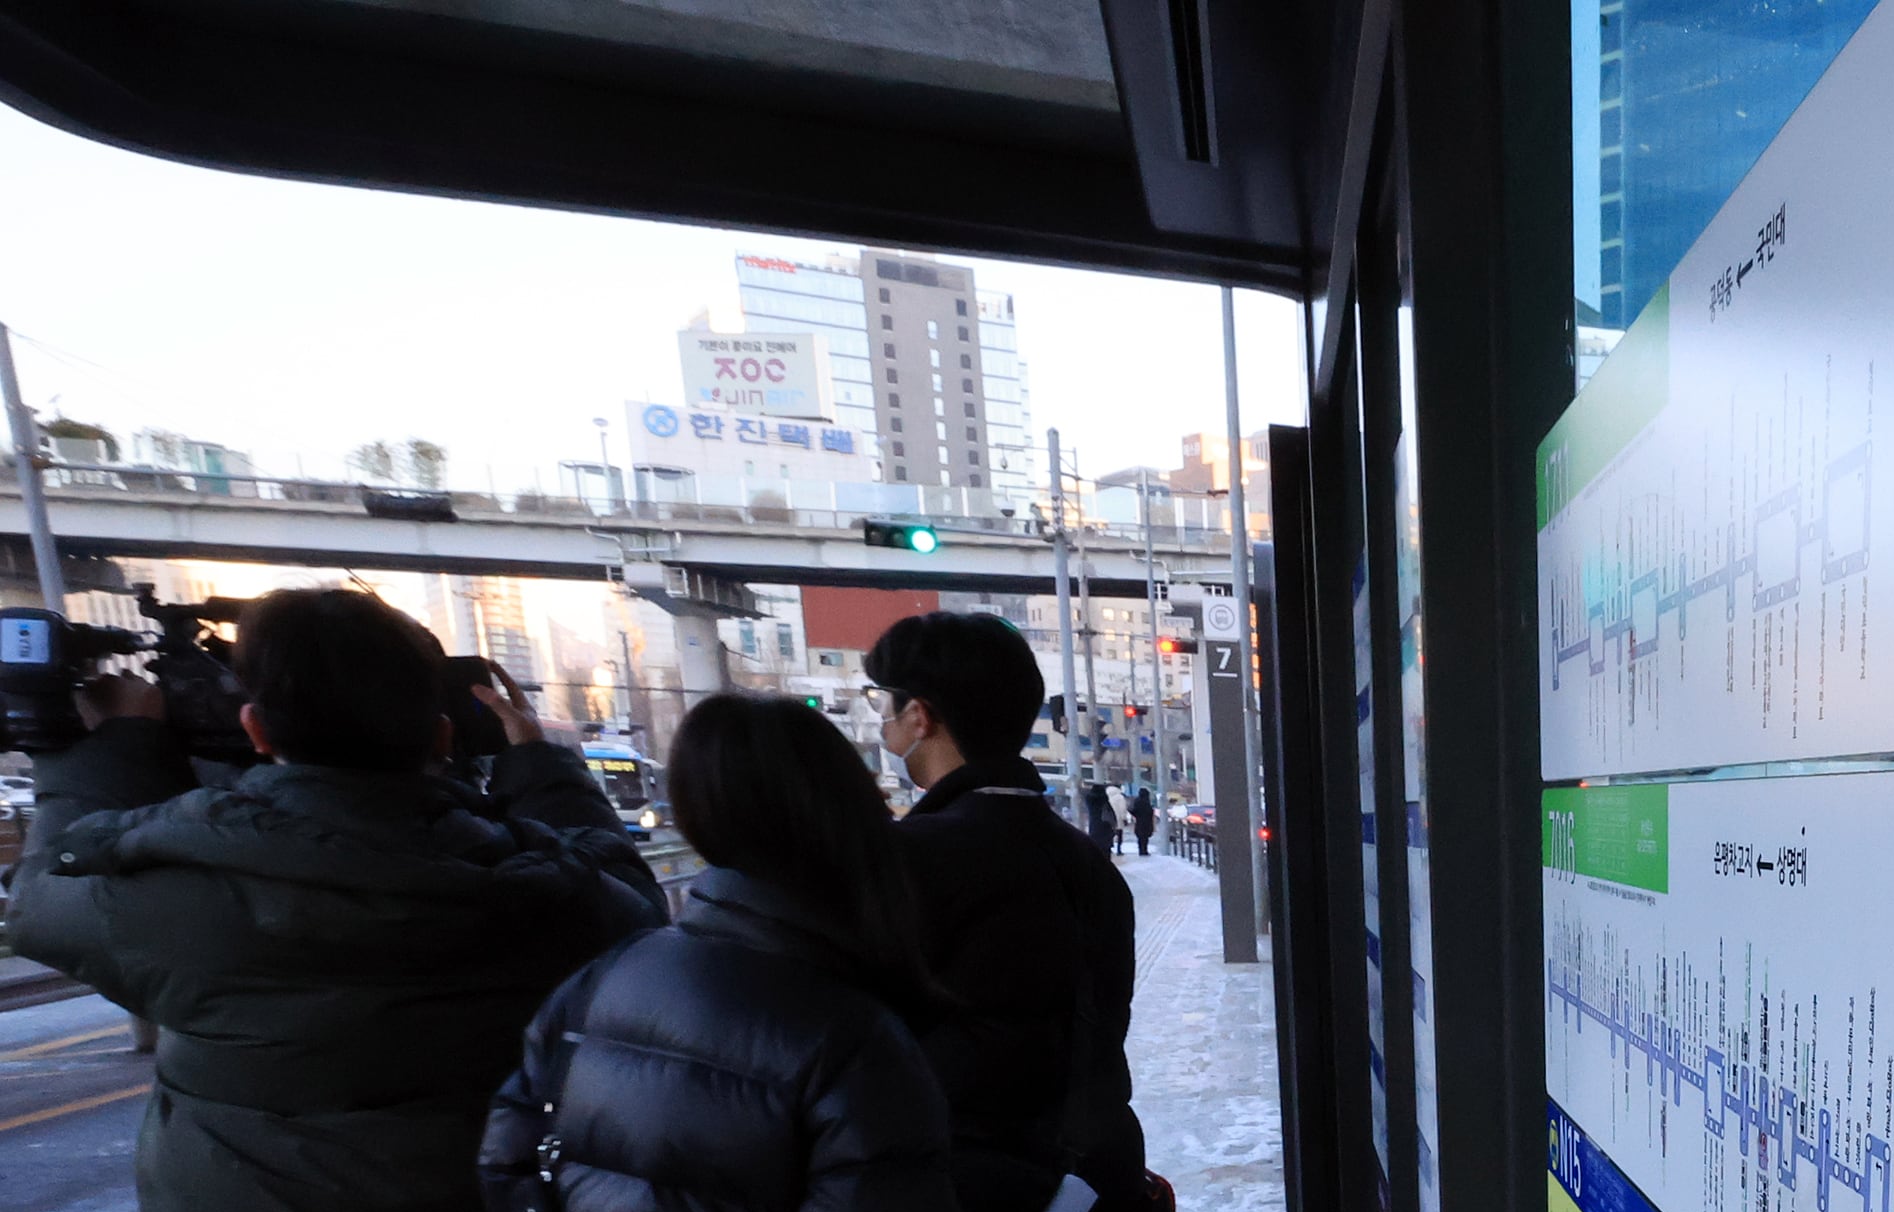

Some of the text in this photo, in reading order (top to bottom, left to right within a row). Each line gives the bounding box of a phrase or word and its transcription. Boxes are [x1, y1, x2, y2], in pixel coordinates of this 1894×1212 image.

[1709, 201, 1785, 323] 공덕동 국민대
[689, 413, 855, 455] 한진택배
[1216, 647, 1231, 670] 7
[1549, 810, 1576, 885] 7016
[1714, 841, 1807, 887] 은평차고지 상명대
[1559, 1115, 1582, 1198] N15
